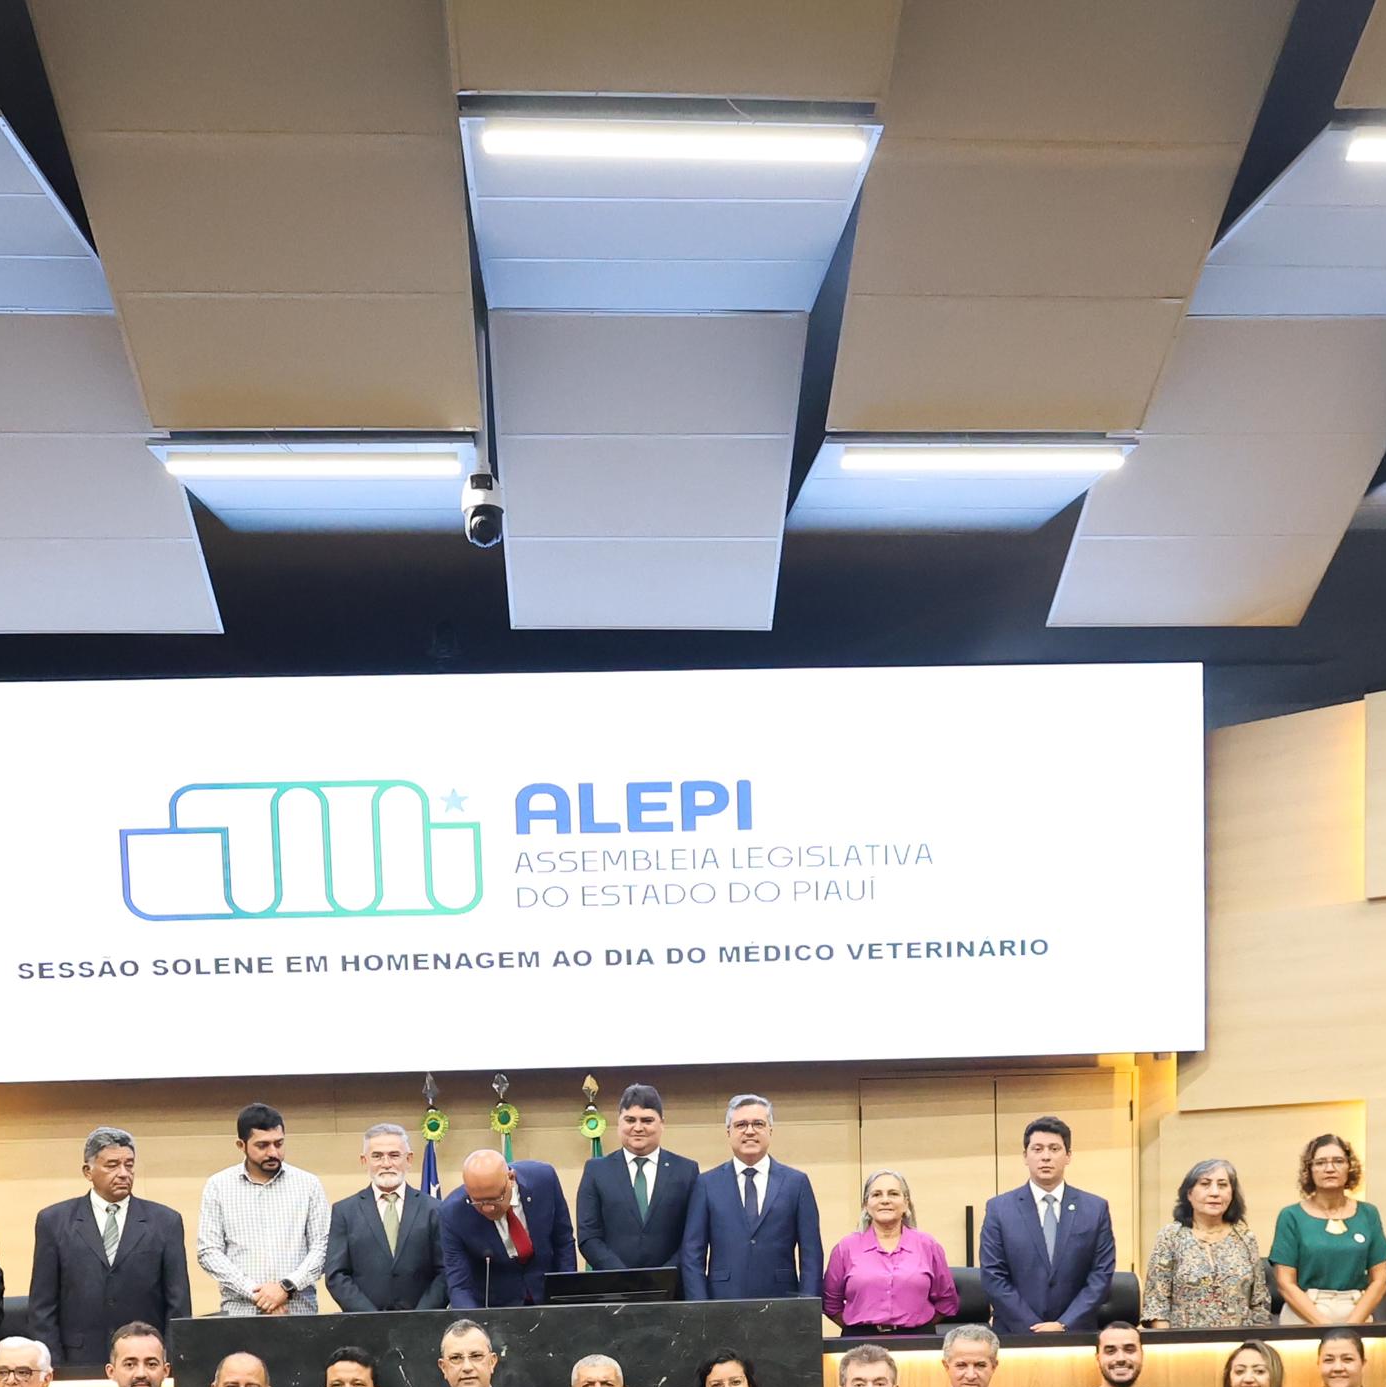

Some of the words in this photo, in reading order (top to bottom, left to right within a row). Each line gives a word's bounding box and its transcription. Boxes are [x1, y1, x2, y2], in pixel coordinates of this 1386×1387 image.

[515, 779, 753, 835] ALEPI
[514, 847, 720, 874] ASSEMBLEIA
[731, 842, 934, 869] LEGISLATIVA
[516, 885, 569, 909] DO
[581, 881, 717, 907] ESTADO
[728, 880, 781, 903] DO
[793, 876, 876, 902] PIAUÍ
[17, 956, 140, 980] SESSÃO
[151, 956, 275, 977] SOLENE
[285, 954, 329, 974] EM
[340, 950, 540, 973] HOMENAGEM
[551, 949, 593, 968] AO
[604, 947, 656, 967] DIA
[665, 946, 707, 966] DO
[718, 941, 835, 964] MÉDICO
[845, 935, 1050, 961] VETERINÁRIO
